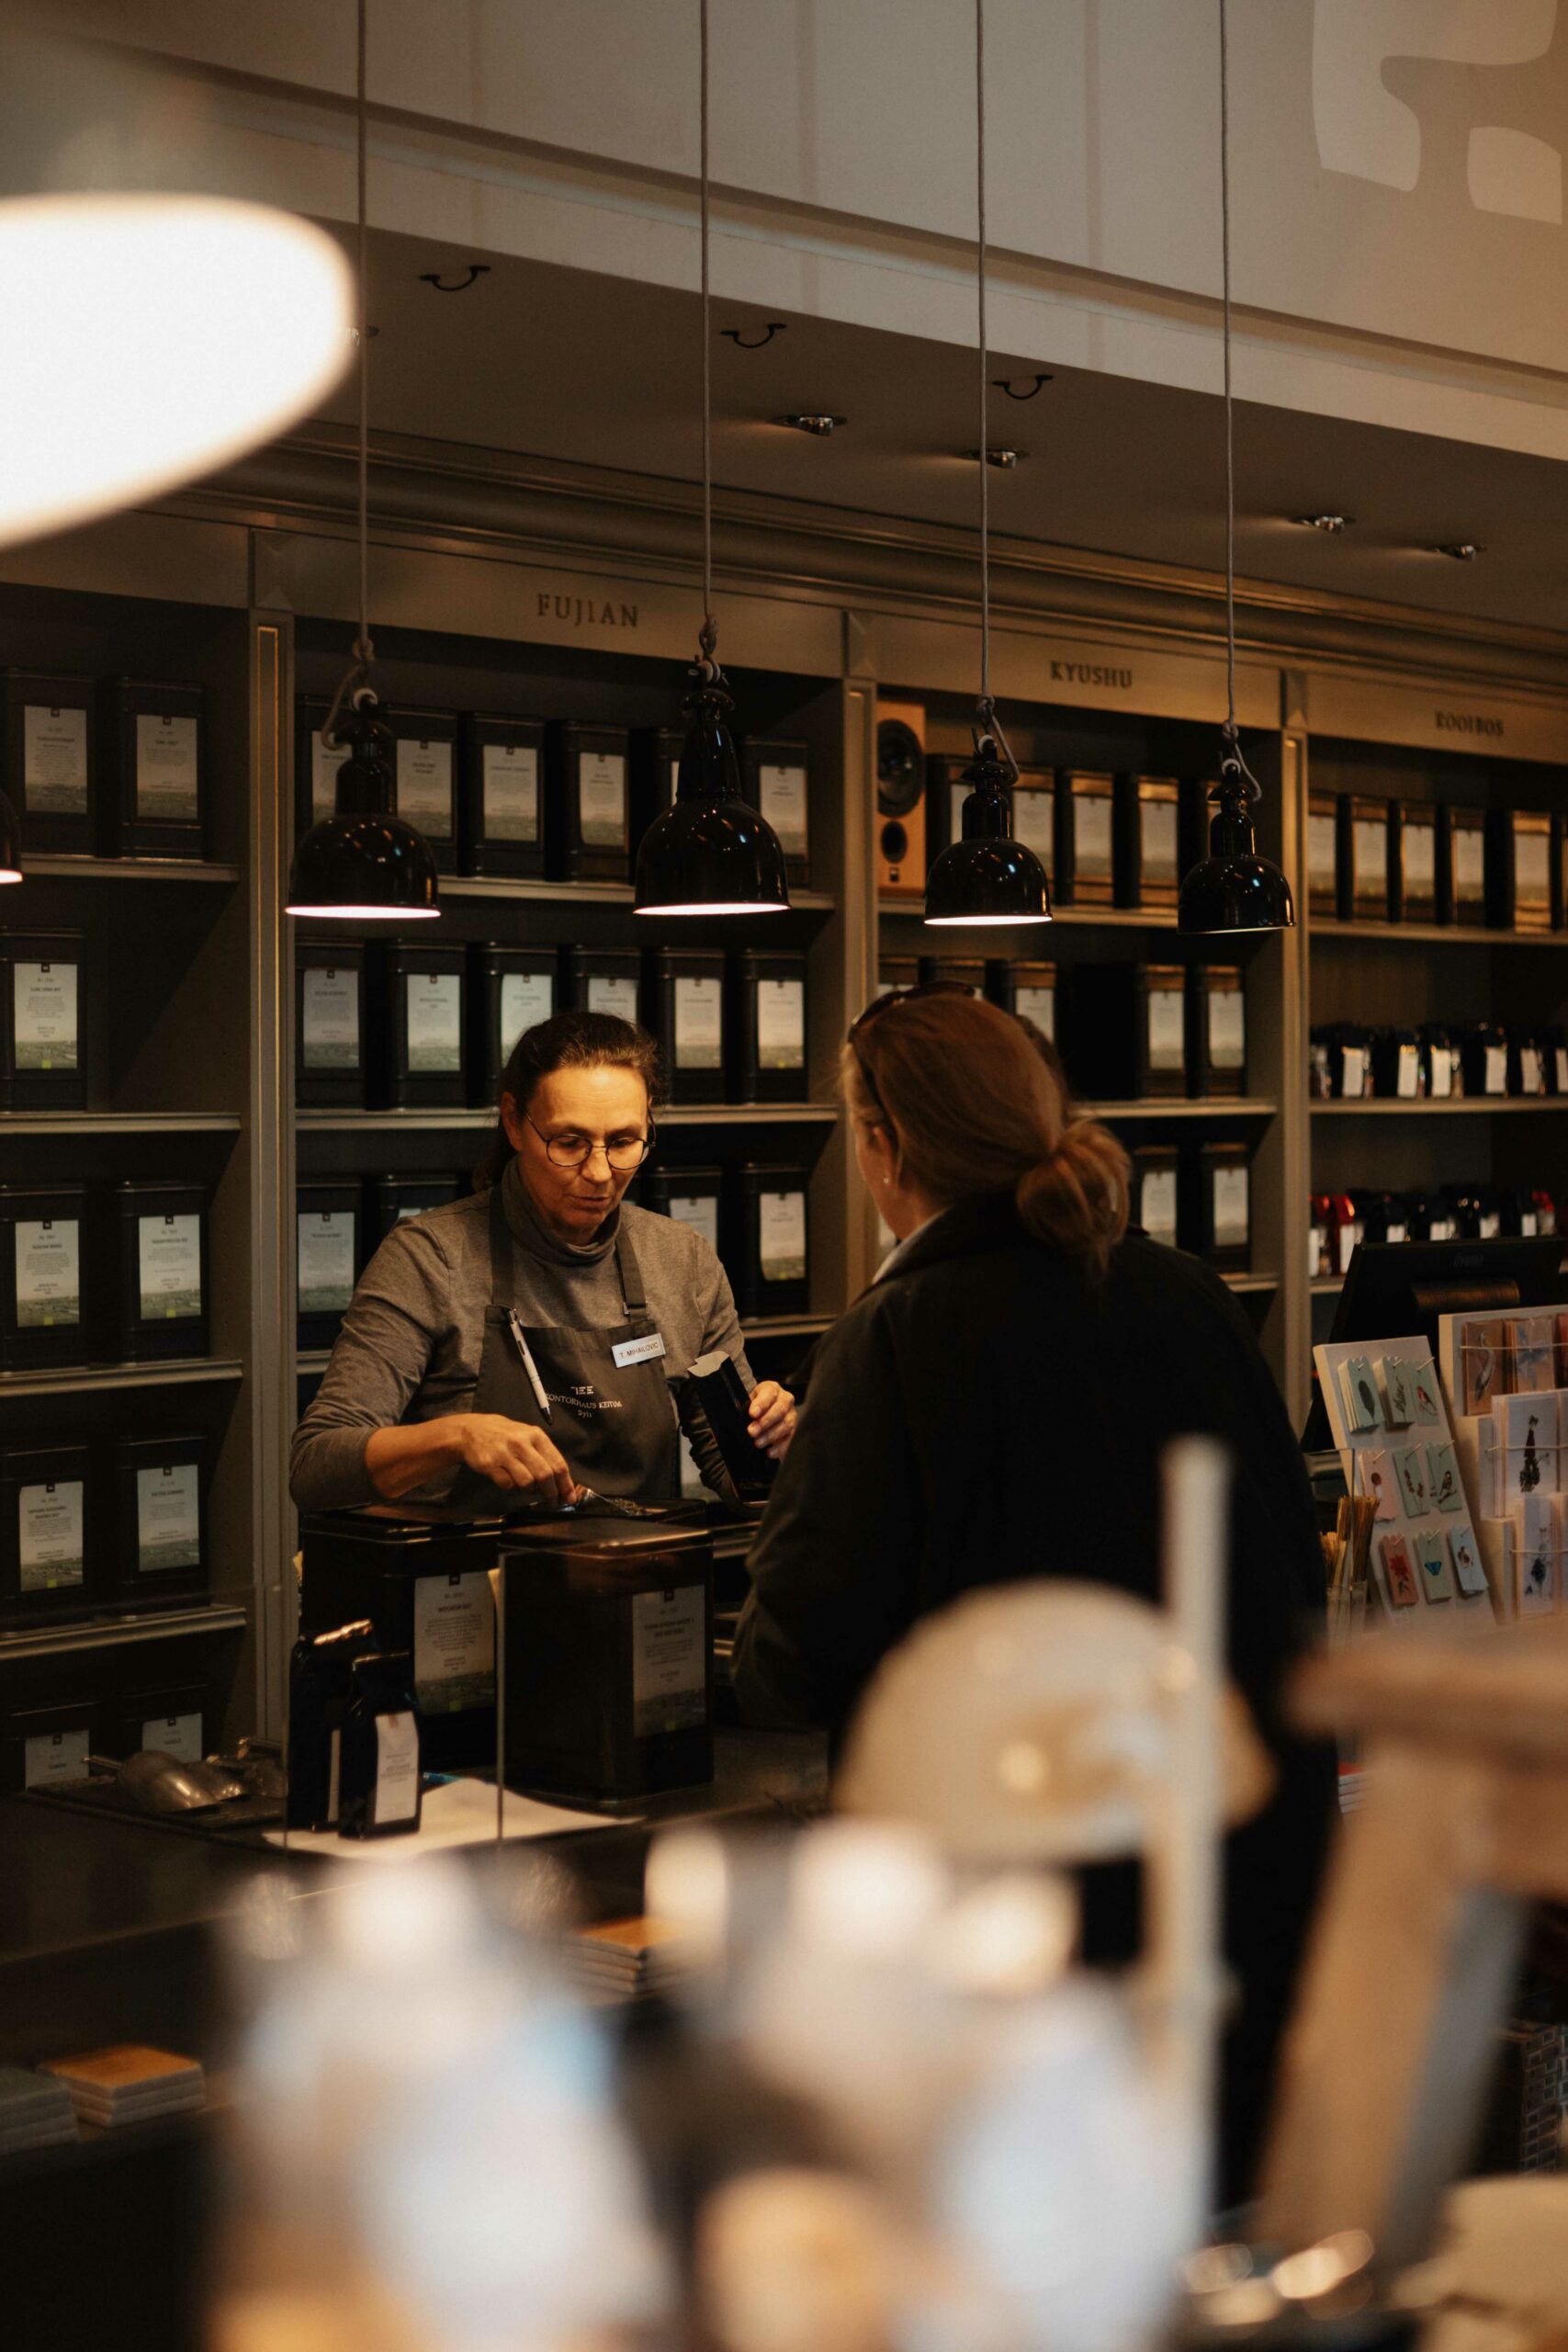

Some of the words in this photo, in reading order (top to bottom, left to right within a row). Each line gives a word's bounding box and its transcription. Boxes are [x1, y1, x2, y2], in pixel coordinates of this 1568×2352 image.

[537, 593, 638, 628] FUJIAN
[1050, 660, 1133, 690] KYUSHU
[1435, 710, 1504, 736] ROOIBOS
[570, 1385, 594, 1396] TEE
